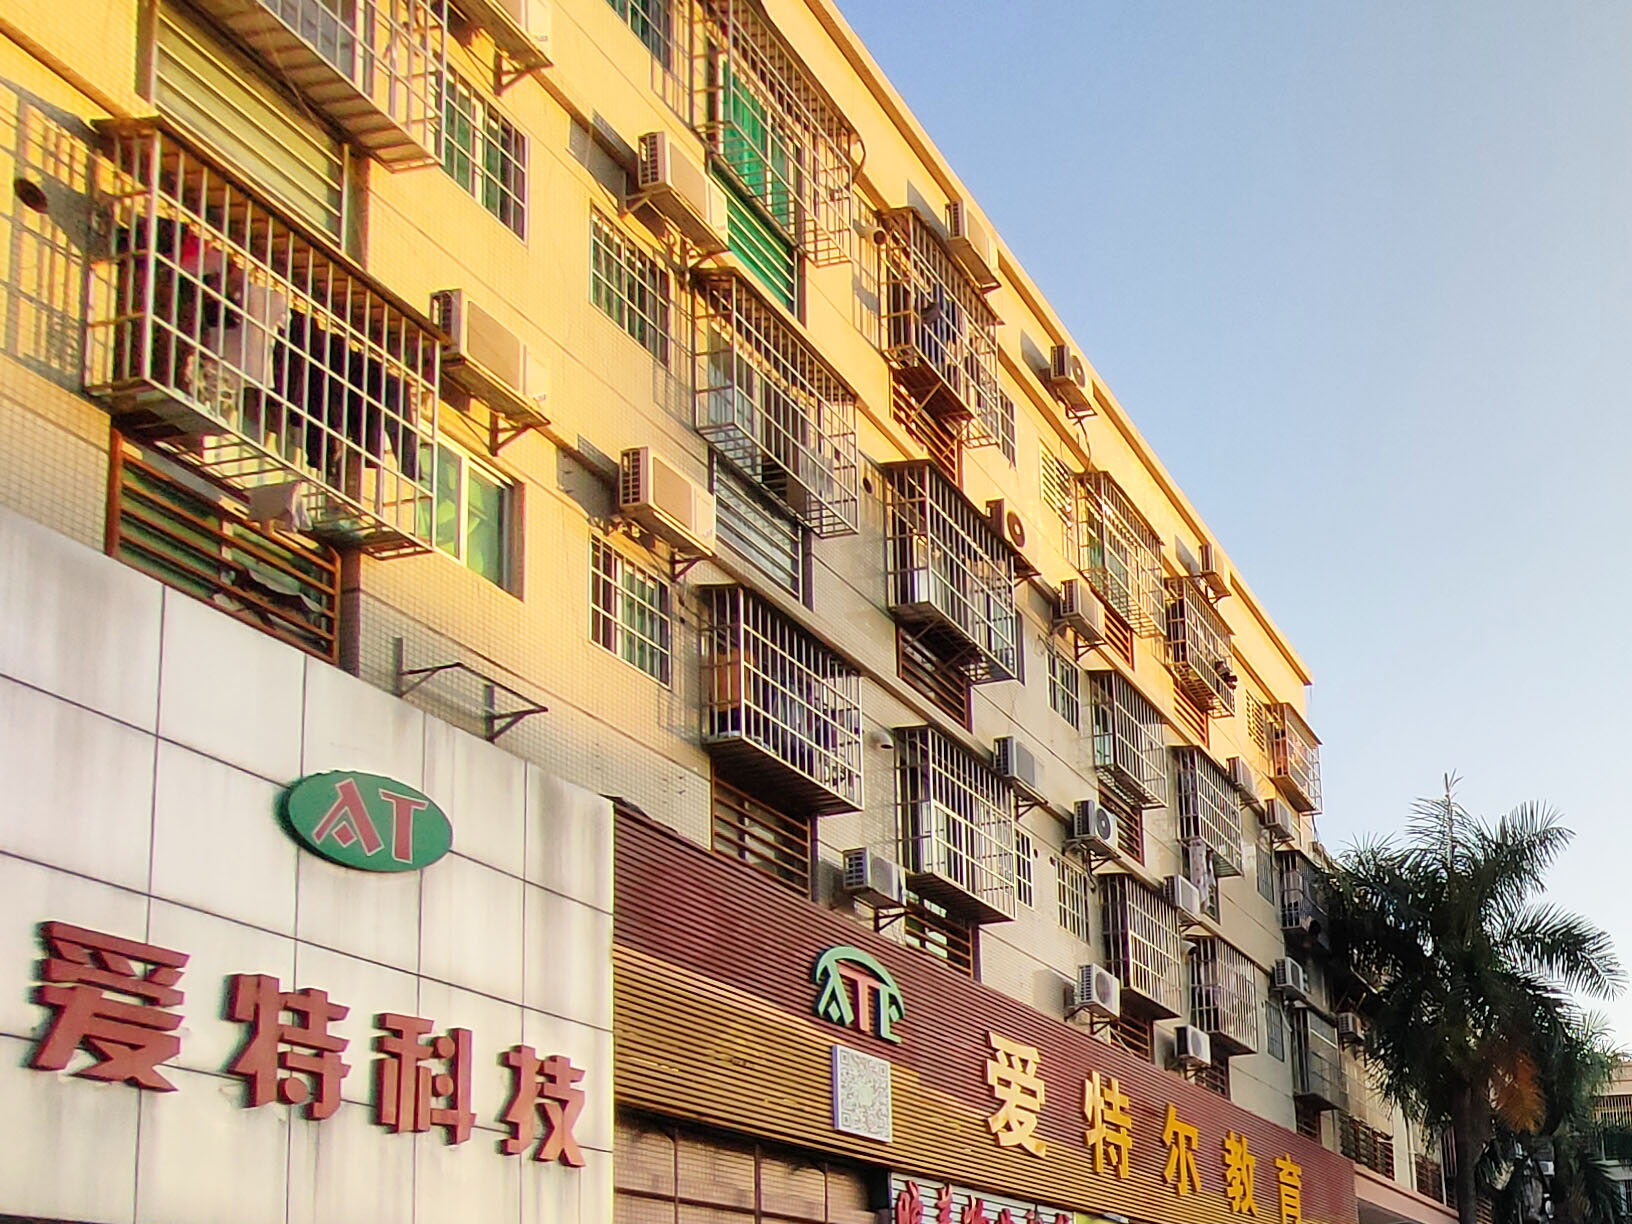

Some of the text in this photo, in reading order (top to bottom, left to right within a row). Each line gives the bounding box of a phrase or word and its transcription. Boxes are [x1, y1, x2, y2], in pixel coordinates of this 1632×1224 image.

[312, 778, 428, 863] AT
[28, 920, 588, 1168] 爱特科技
